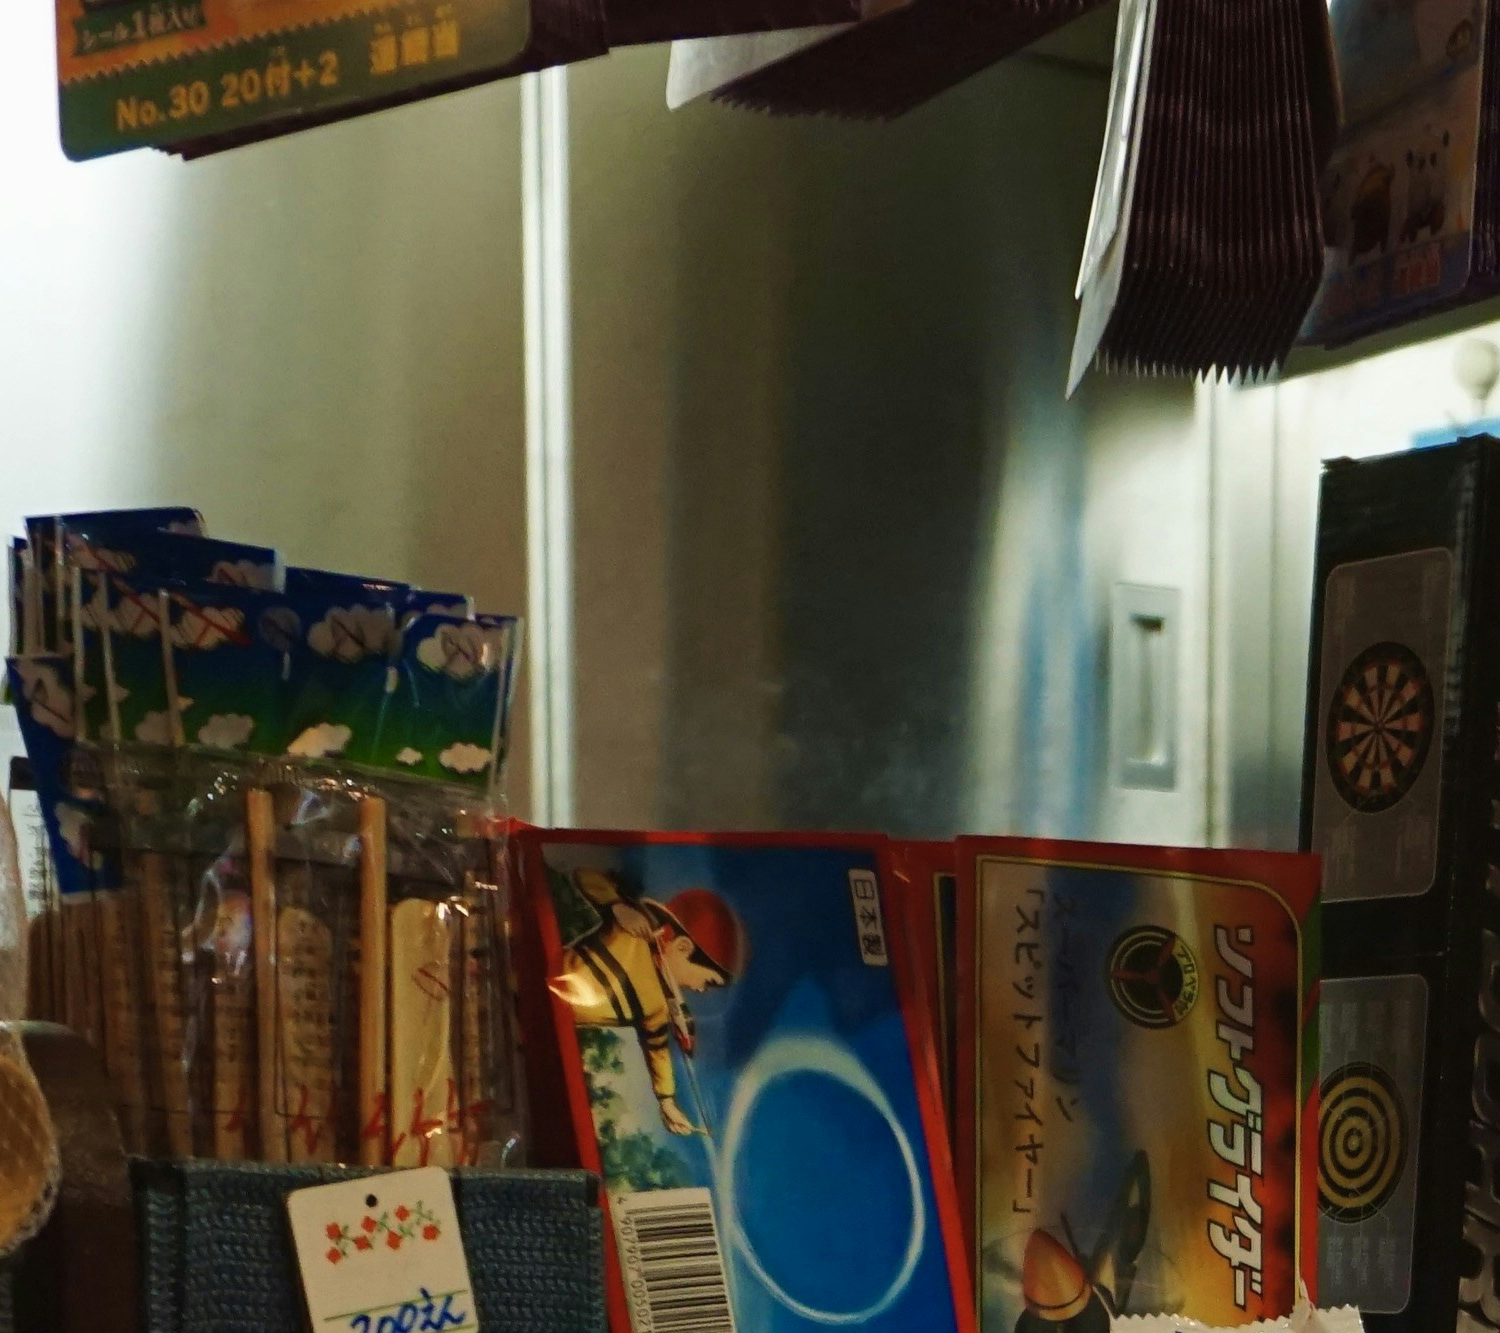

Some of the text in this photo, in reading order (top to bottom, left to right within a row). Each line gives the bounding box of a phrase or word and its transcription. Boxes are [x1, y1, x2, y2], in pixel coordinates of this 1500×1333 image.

[115, 81, 208, 132] No.30
[854, 876, 883, 958] 日本製
[1205, 924, 1266, 1312] ソフトグライダー
